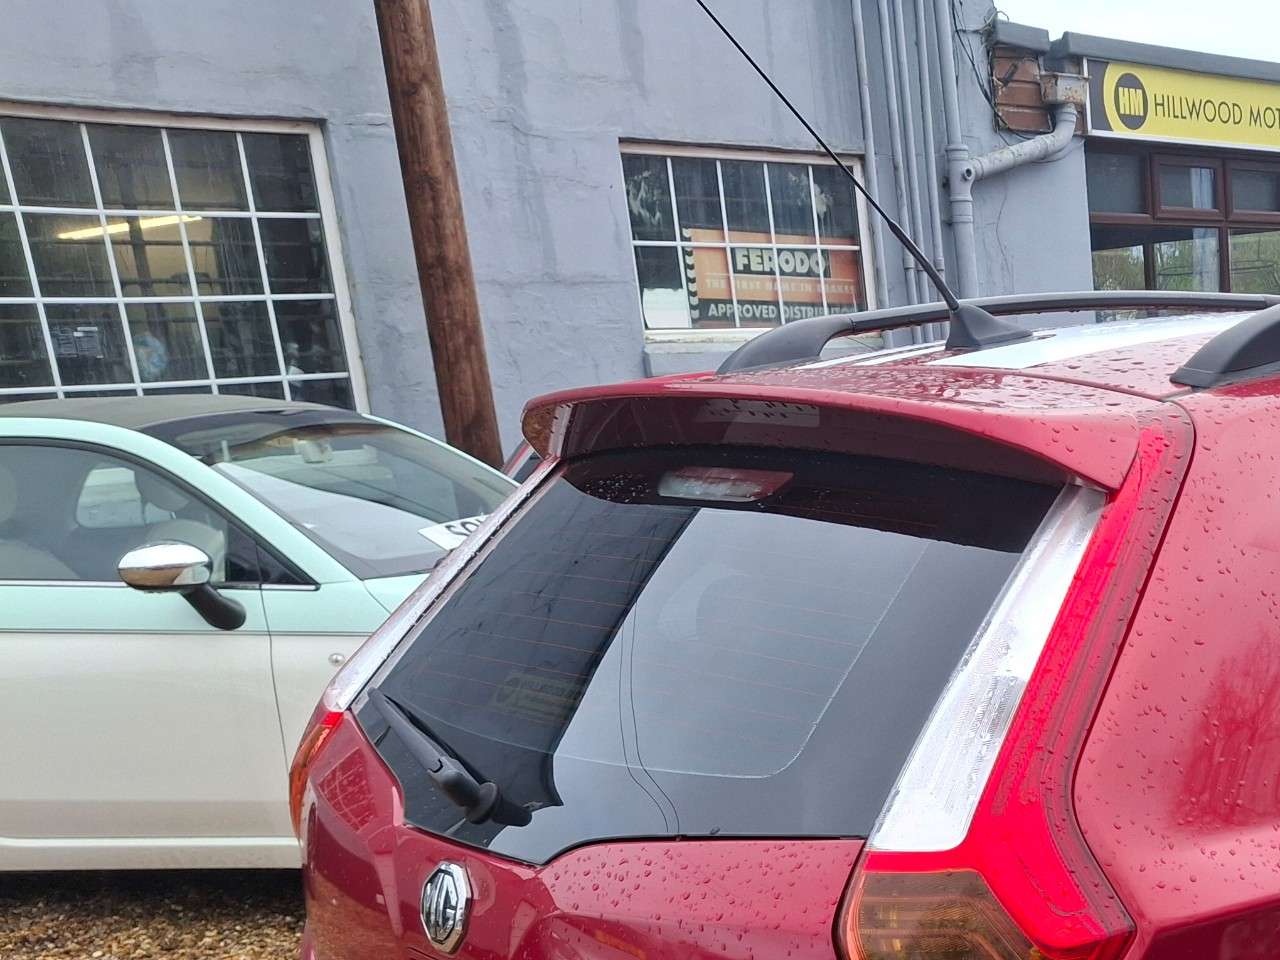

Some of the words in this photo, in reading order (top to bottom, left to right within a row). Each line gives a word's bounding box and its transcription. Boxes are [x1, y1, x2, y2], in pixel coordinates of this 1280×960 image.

[1118, 87, 1144, 116] HM
[1154, 93, 1242, 125] HILLWOOD
[735, 248, 826, 274] FERODO
[708, 303, 777, 319] APPROVED
